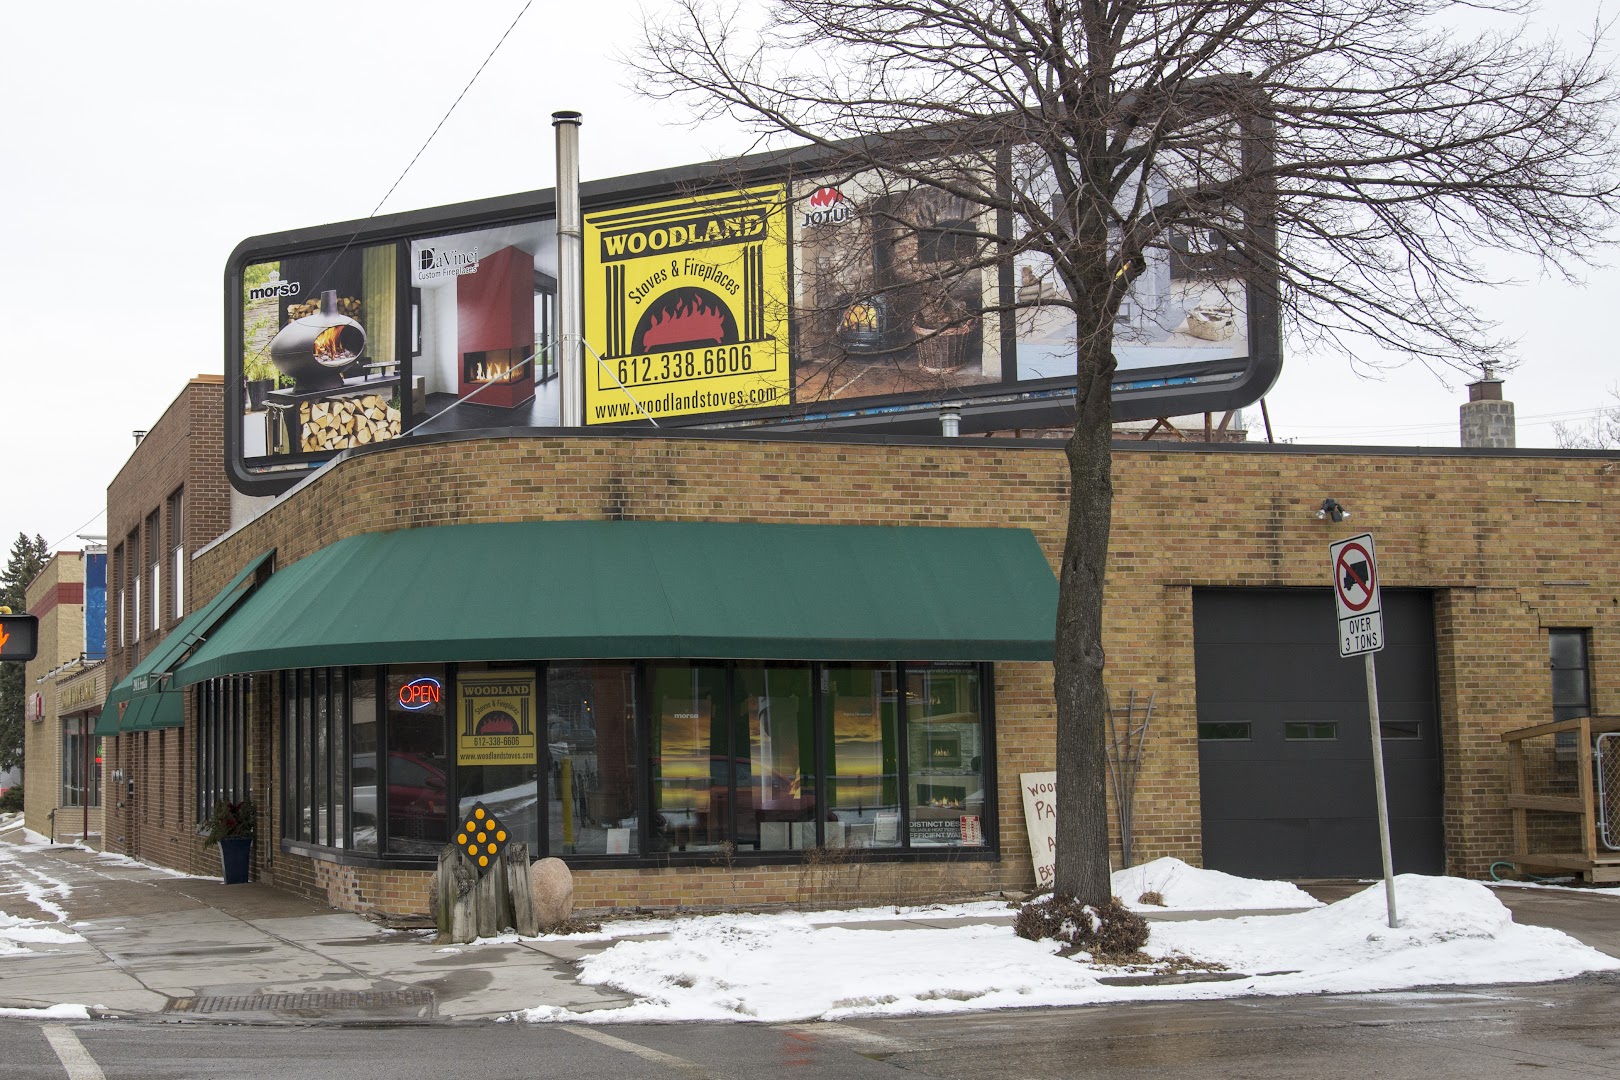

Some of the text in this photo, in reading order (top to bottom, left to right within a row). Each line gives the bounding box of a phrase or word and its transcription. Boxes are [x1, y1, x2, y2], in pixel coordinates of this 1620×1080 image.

[603, 214, 764, 256] WOODLAND
[418, 246, 479, 271] DaVinci
[418, 266, 477, 281] Custom Fireplaces
[628, 257, 740, 305] Stoves & Fireplaces
[617, 345, 752, 385] 612.338.6606
[595, 386, 778, 419] www.woodlandstoves.com
[1349, 617, 1371, 635] OVER
[1345, 632, 1378, 652] 3 TONS
[399, 685, 440, 703] OPEN
[464, 685, 530, 697] WOODLAND
[474, 702, 492, 716] Stoves
[473, 736, 520, 747] 612-338-6606
[460, 751, 534, 761] www.woodlandstoves.com
[1027, 783, 1057, 797] WOO
